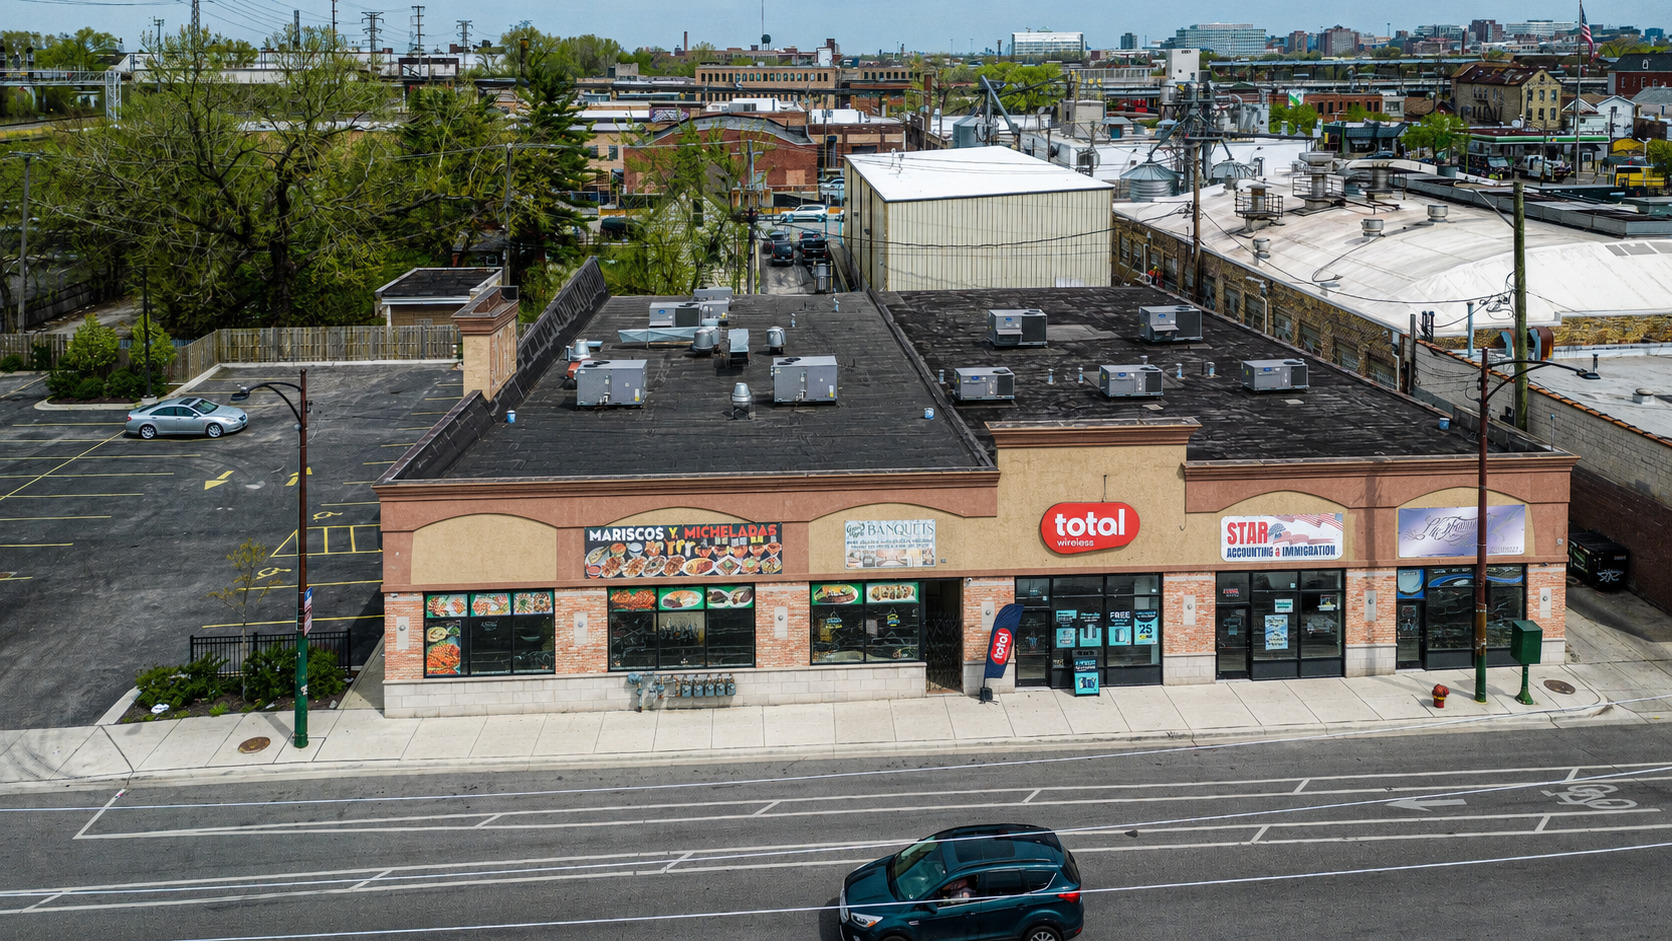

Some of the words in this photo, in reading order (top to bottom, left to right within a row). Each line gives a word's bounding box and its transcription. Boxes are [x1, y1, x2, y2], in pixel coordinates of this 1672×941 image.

[1054, 508, 1125, 537] total
[589, 527, 665, 542] MARISCOS
[668, 527, 678, 539] Y
[684, 524, 777, 539] MICHELADAS
[1056, 537, 1094, 547] wireless
[1227, 521, 1268, 545] STAR
[1226, 546, 1274, 558] ACCOUNTING
[1282, 545, 1336, 557] IMMIGRATION
[1109, 611, 1131, 619] FREE
[993, 632, 1009, 659] total
